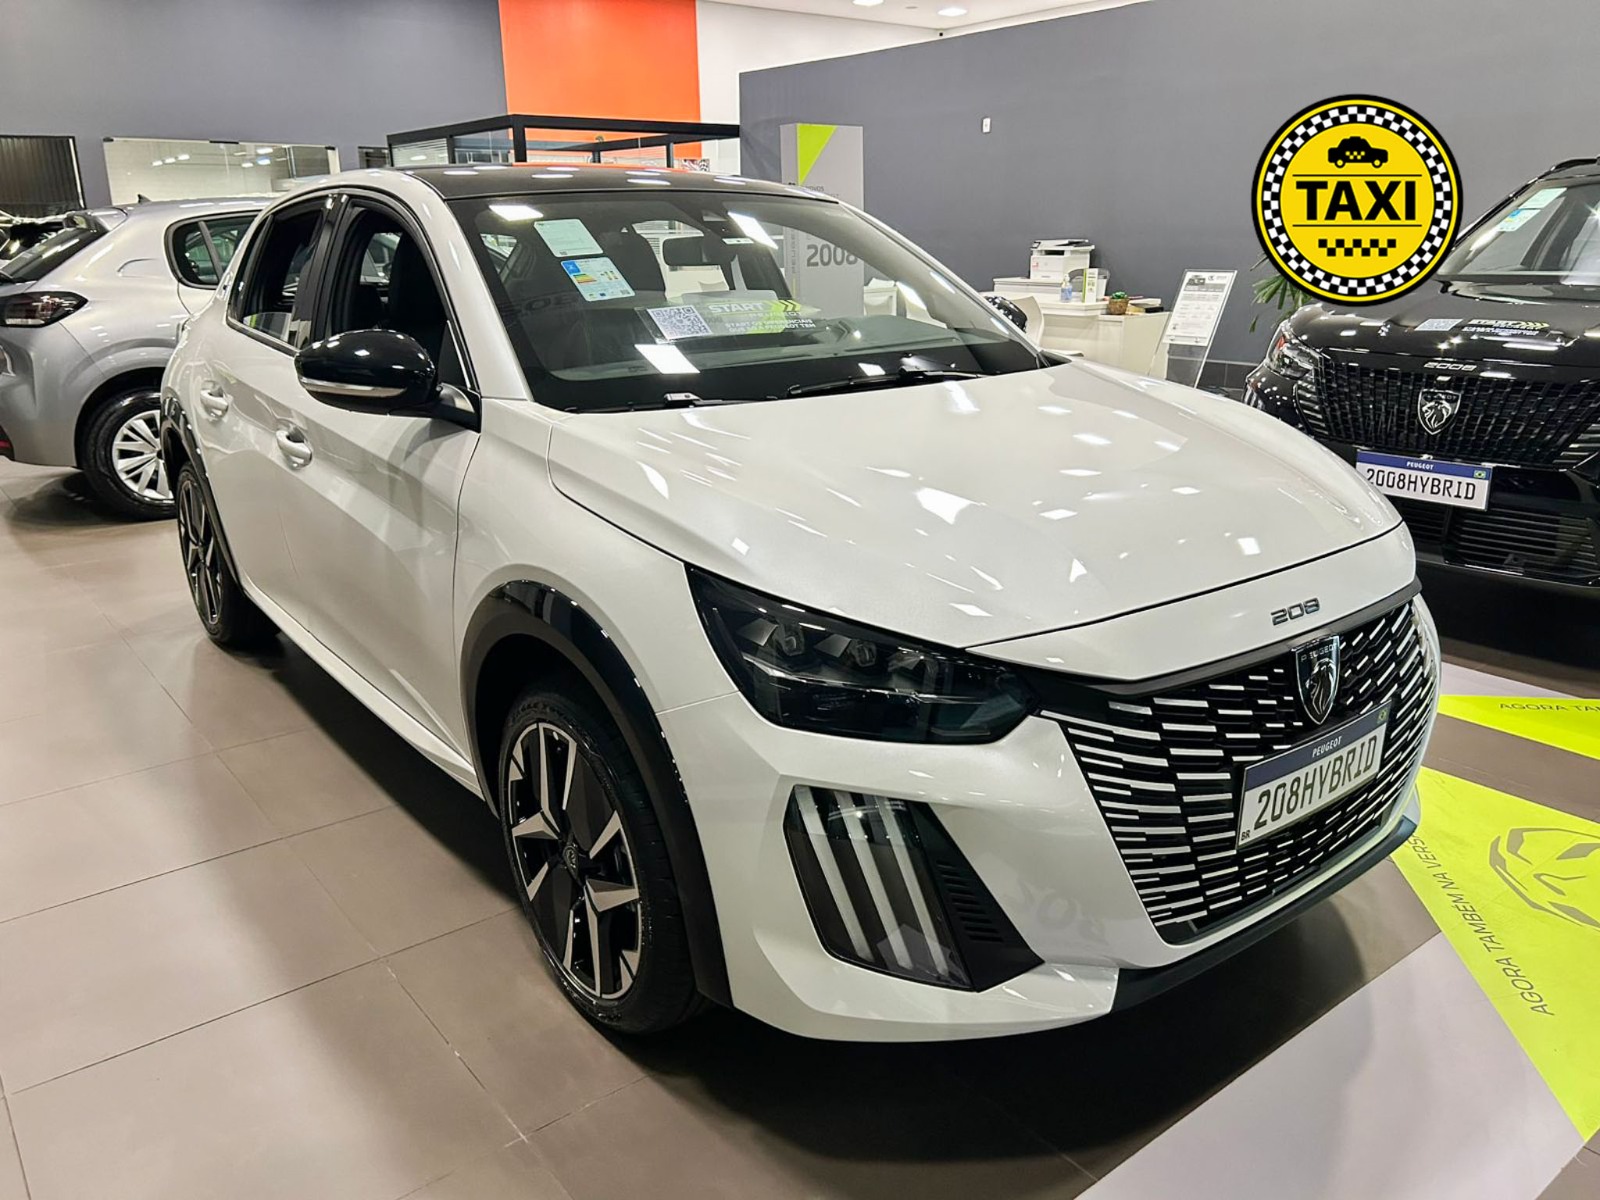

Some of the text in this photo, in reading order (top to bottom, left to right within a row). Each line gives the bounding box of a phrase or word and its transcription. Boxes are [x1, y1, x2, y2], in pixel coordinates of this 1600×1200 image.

[709, 303, 763, 313] START
[1423, 361, 1478, 371] 2008
[1406, 461, 1434, 470] PEUGEOT
[1366, 468, 1476, 500] 2008HYBRID
[1270, 597, 1321, 626] 208
[1500, 703, 1569, 711] AGORA
[1312, 736, 1342, 758] PEUGEOT
[1254, 735, 1377, 830] 208HYBRID
[1241, 830, 1251, 841] BR
[1433, 872, 1461, 890] NA
[1446, 893, 1505, 953] TAMBÉM
[1495, 957, 1556, 1016] AGORA
